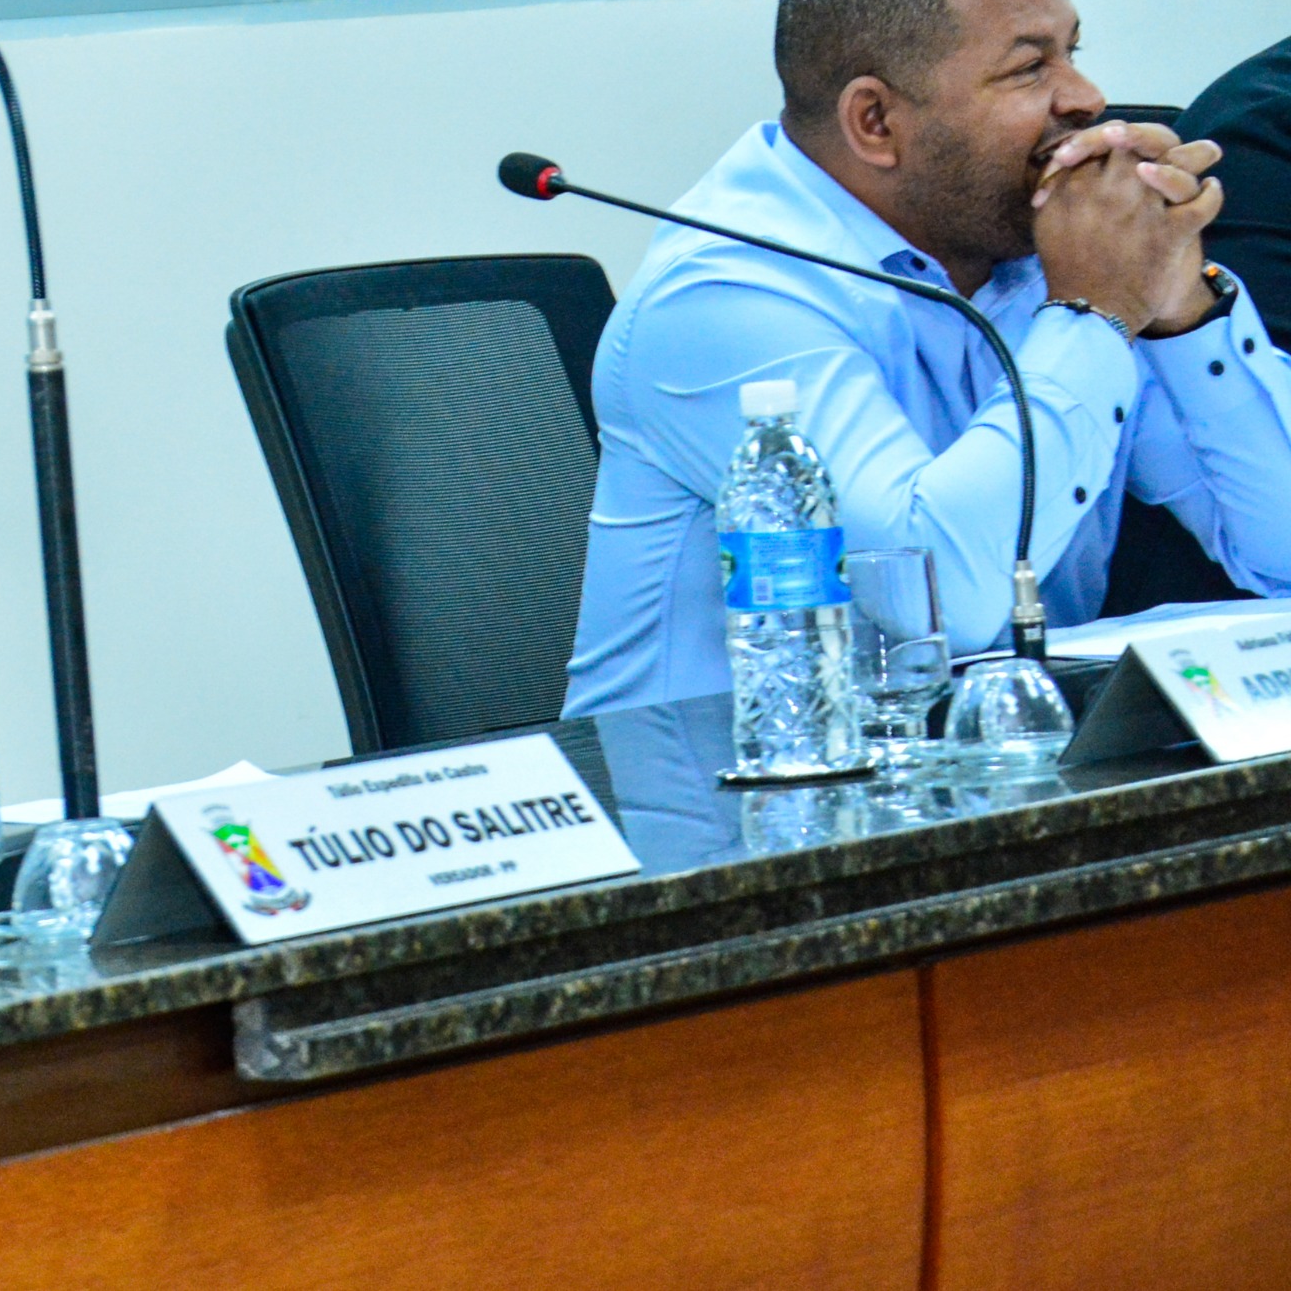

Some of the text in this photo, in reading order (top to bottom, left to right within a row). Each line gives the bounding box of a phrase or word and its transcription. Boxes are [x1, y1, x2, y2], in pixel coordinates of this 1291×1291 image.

[288, 792, 595, 871] TÚLIO DO SALITRE
[428, 863, 495, 885] VEREADOR
